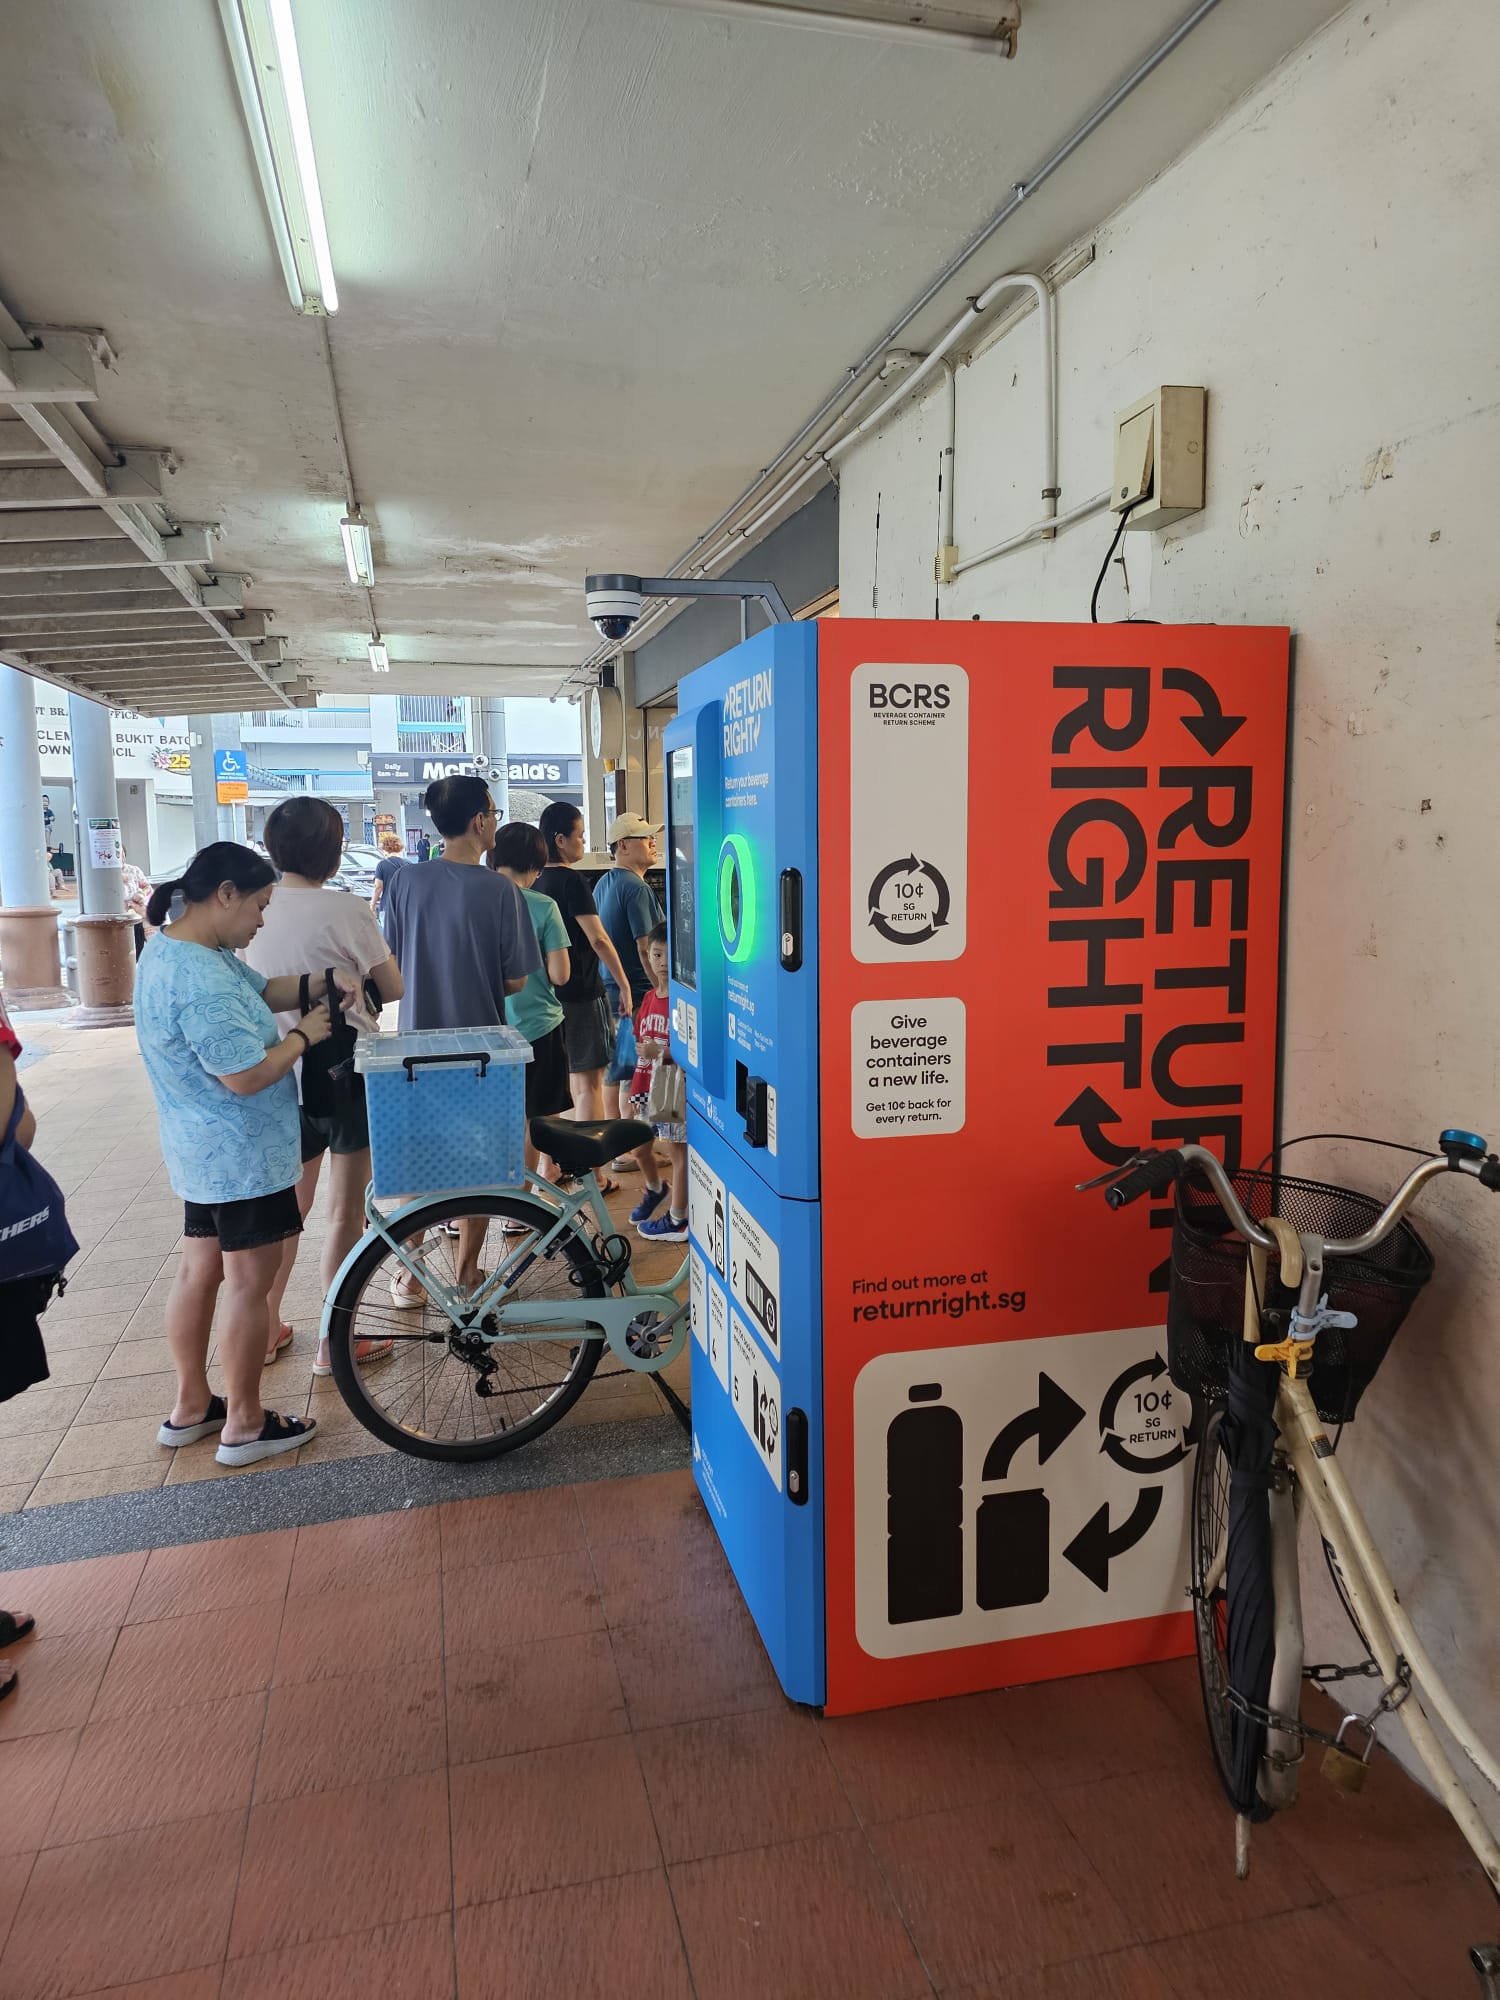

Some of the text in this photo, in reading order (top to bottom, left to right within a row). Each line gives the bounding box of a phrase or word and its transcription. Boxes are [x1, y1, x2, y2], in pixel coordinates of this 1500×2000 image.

[728, 668, 772, 721] RETURN
[869, 683, 951, 709] BCRS
[115, 733, 154, 744] BUKIT
[723, 715, 755, 759] RIGHT
[38, 744, 71, 755] OWN
[384, 763, 401, 771] Daily
[422, 762, 561, 781] McDald's
[1047, 666, 1151, 1090] RIGHT
[894, 882, 924, 899] 10¢
[903, 902, 915, 911] SG
[891, 912, 927, 921] RETURN
[890, 1014, 928, 1029] Give
[870, 1035, 948, 1050] beverage
[866, 1052, 952, 1069] containers
[868, 1070, 949, 1087] a new life.
[866, 1098, 952, 1112] Get 10¢ back for
[875, 1112, 942, 1125] every return.
[0, 1204, 50, 1242] HERS
[732, 1260, 738, 1288] 2
[852, 1270, 989, 1294] Find out more at
[852, 1290, 1027, 1323] returnright.sg
[734, 1375, 739, 1402] 5
[1134, 1390, 1173, 1413] 10¢
[1145, 1417, 1161, 1428] SG
[1129, 1429, 1177, 1444] RETURN
